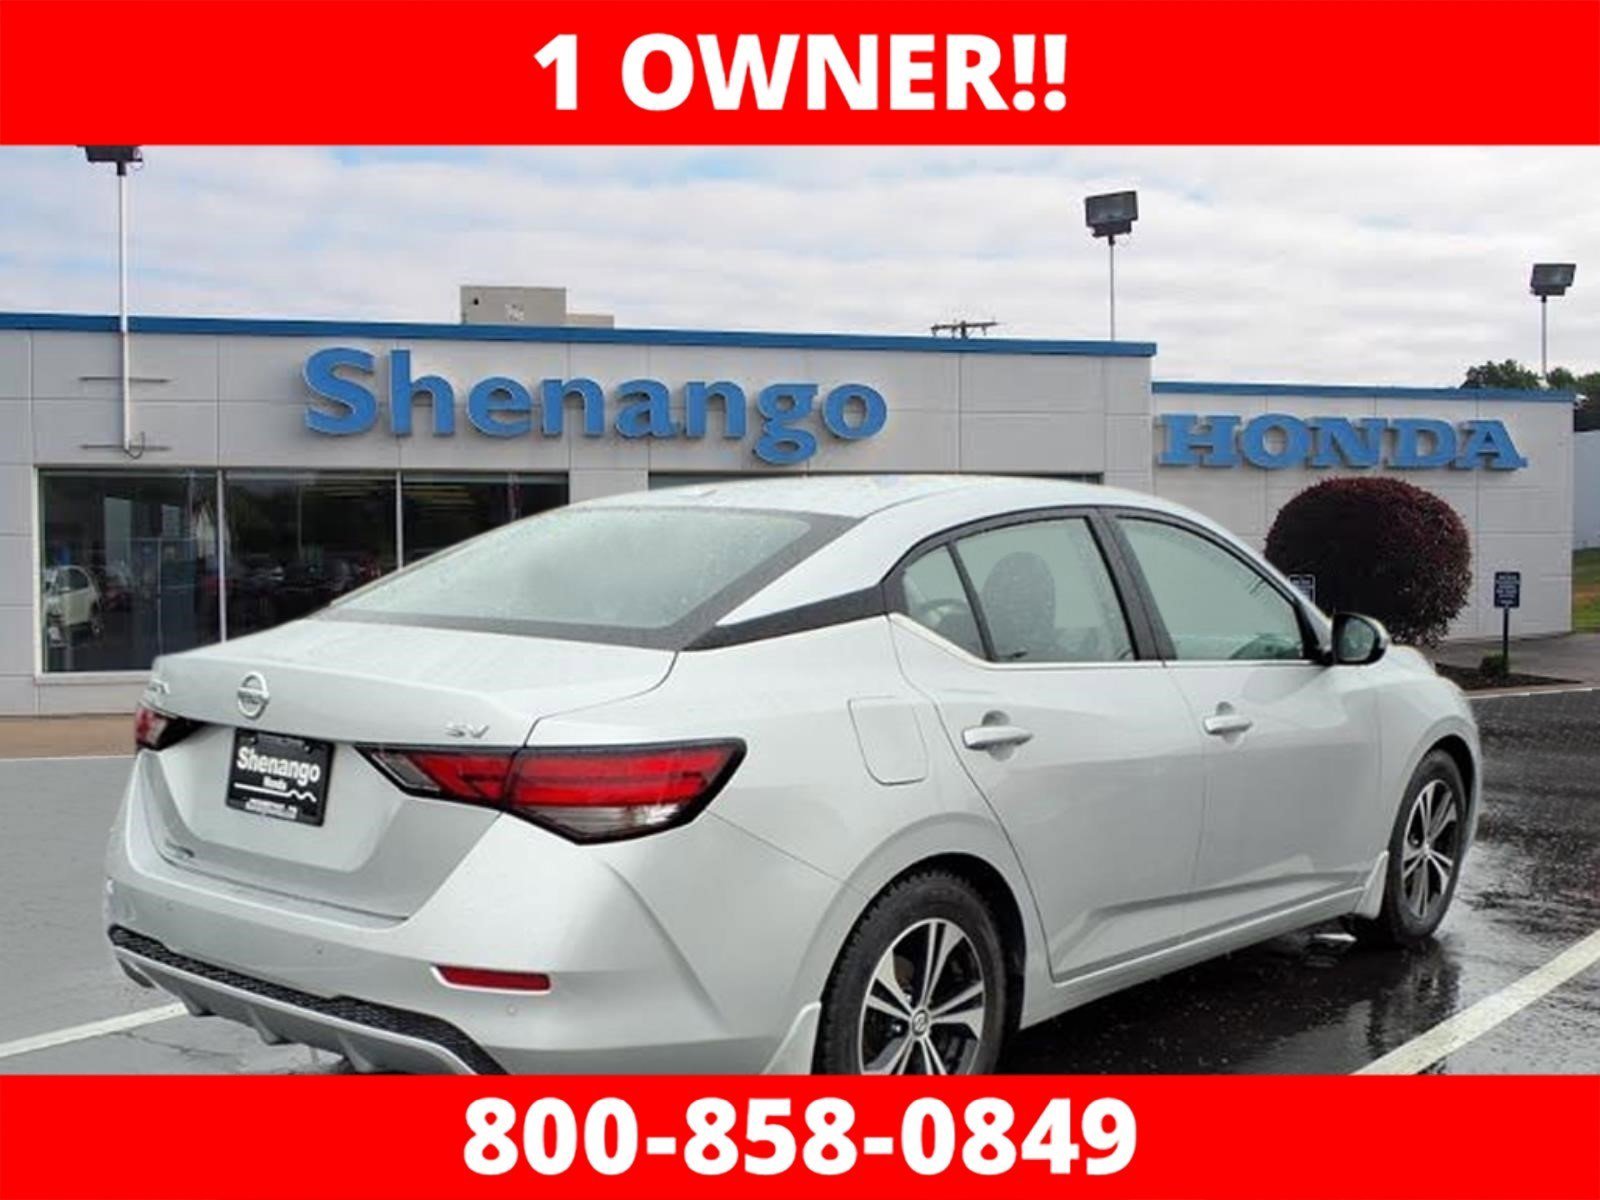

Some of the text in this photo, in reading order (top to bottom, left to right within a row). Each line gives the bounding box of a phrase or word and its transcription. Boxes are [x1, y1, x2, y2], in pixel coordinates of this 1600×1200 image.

[303, 346, 888, 465] Shenango
[1160, 412, 1528, 471] HONDA
[444, 721, 490, 738] SV
[236, 746, 321, 786] Shenango
